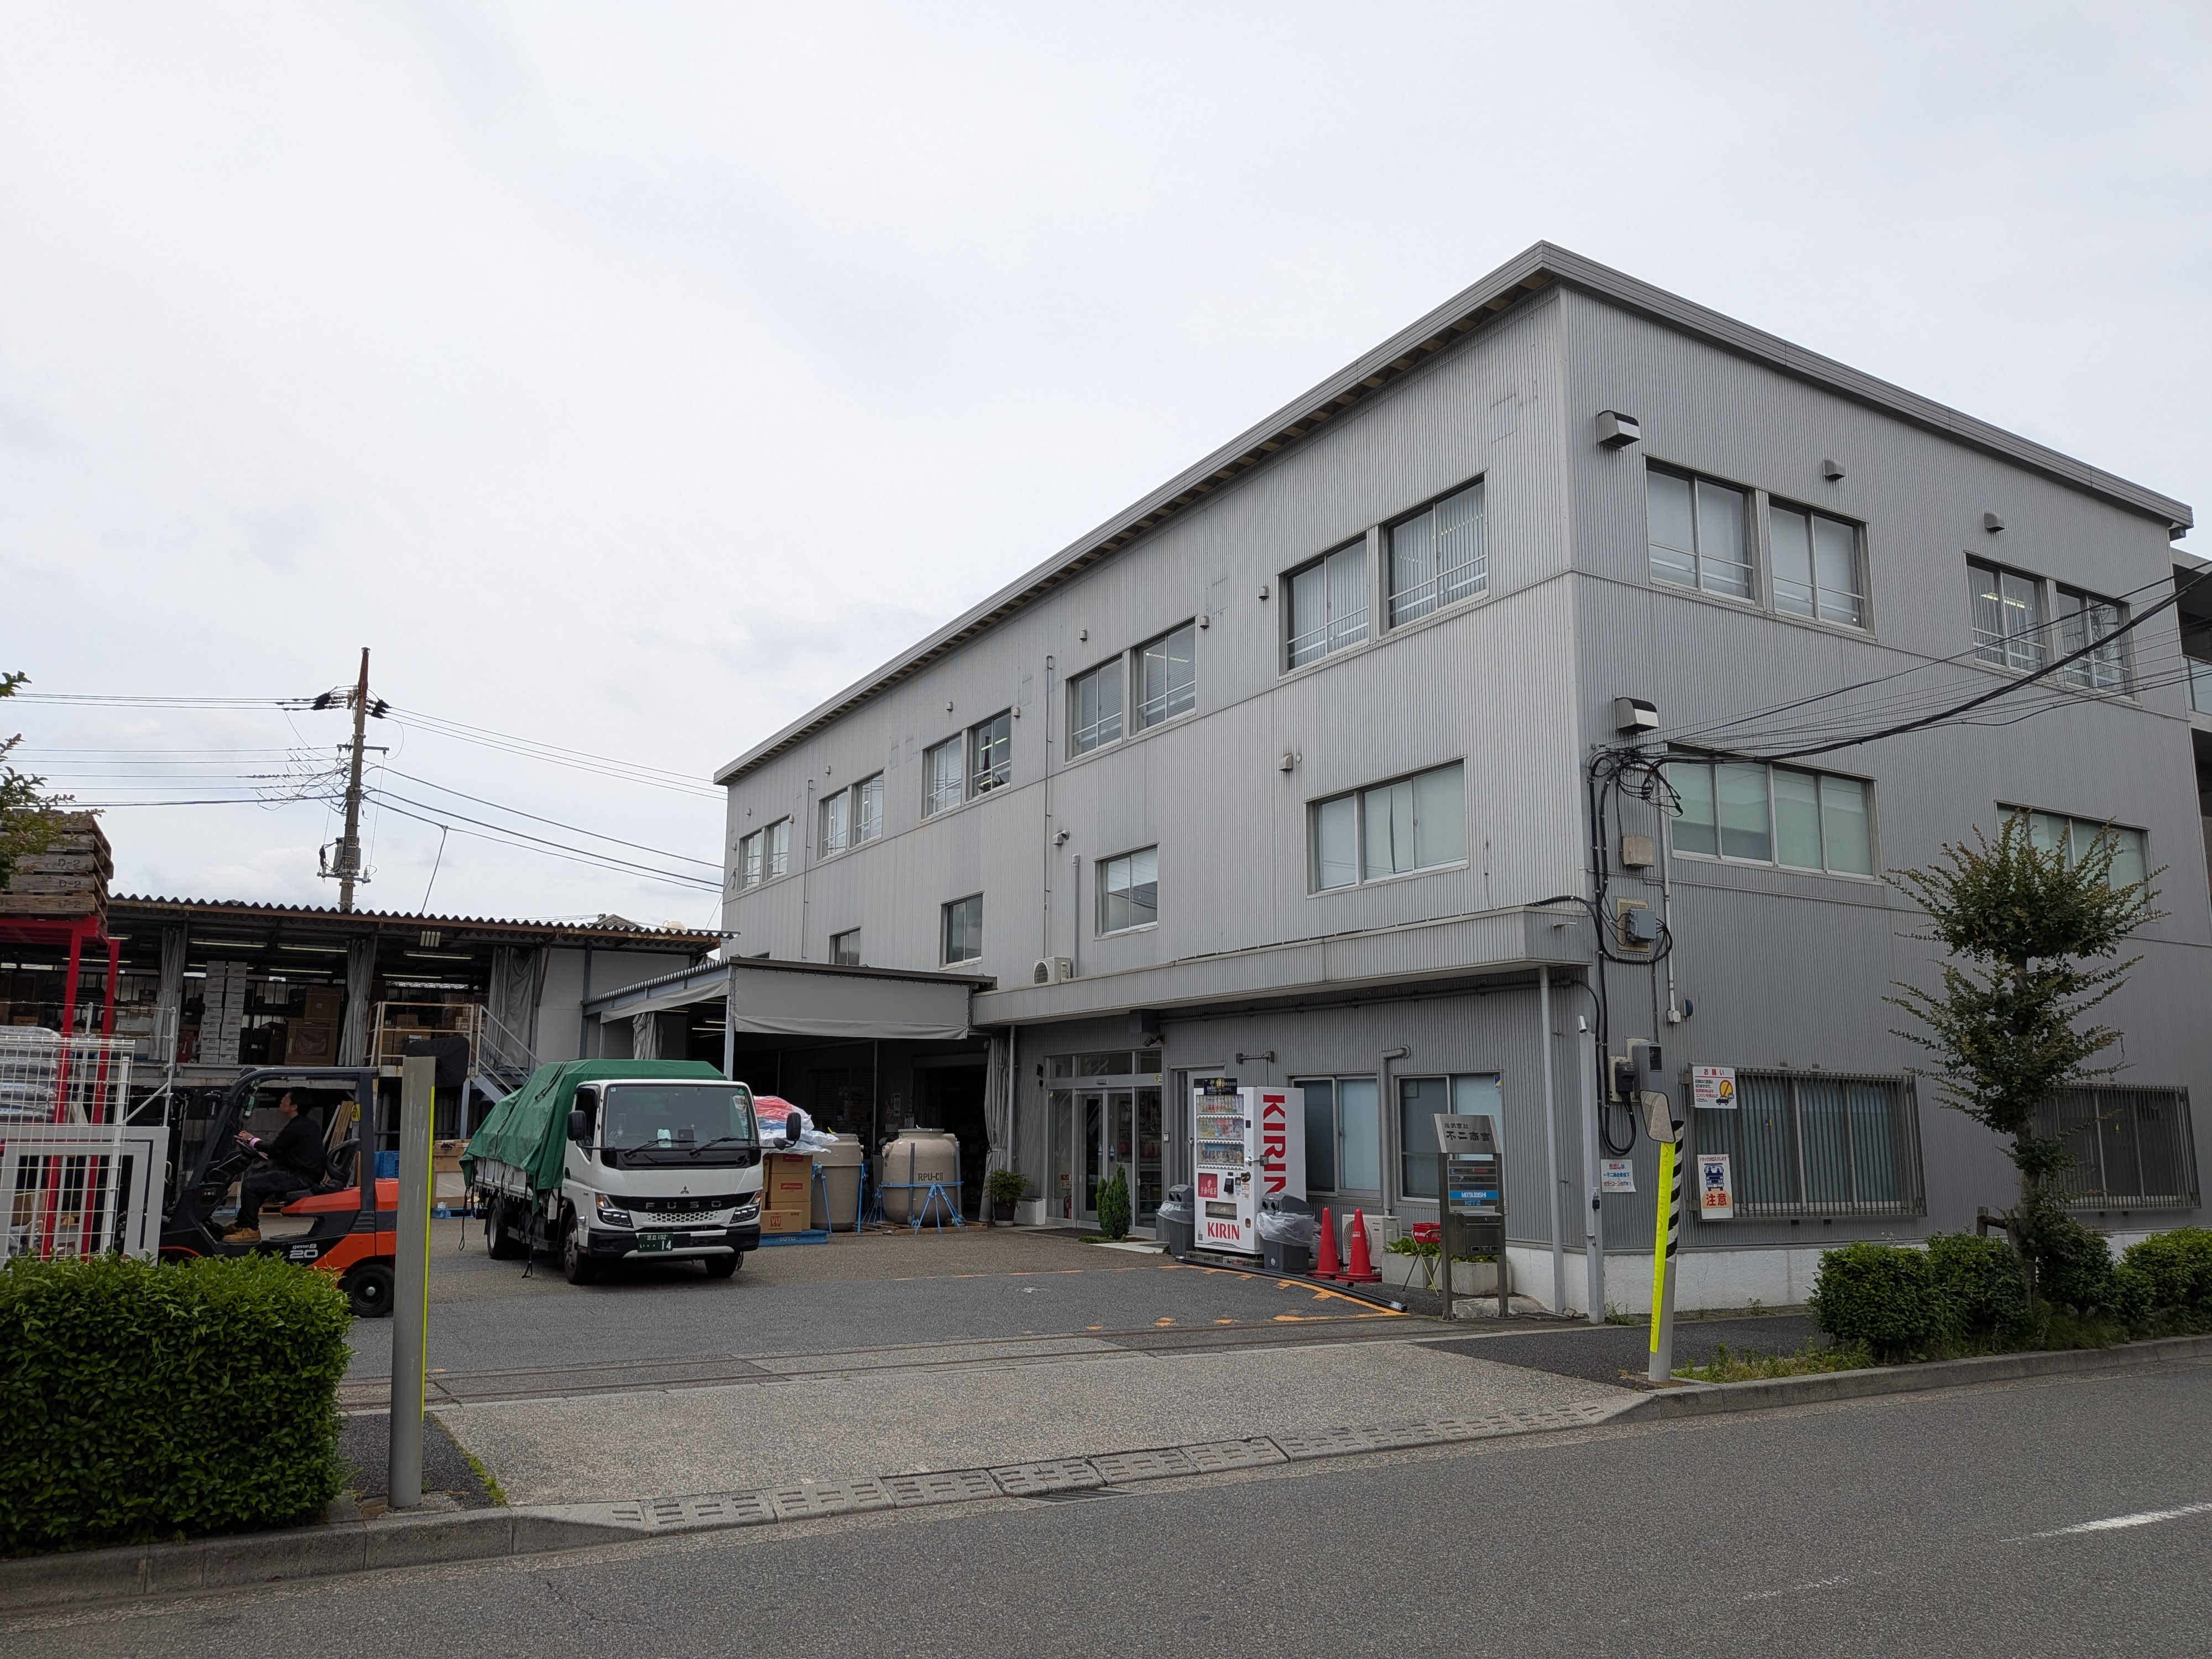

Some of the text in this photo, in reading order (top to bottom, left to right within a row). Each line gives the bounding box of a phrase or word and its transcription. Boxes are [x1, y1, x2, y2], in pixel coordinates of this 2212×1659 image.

[58, 858, 80, 867] D-2
[59, 879, 81, 888] D-2
[1706, 1193, 1727, 1206] 注意
[645, 1201, 722, 1209] FUSO
[1207, 1221, 1240, 1240] KIRIN
[289, 1249, 318, 1259] 20
